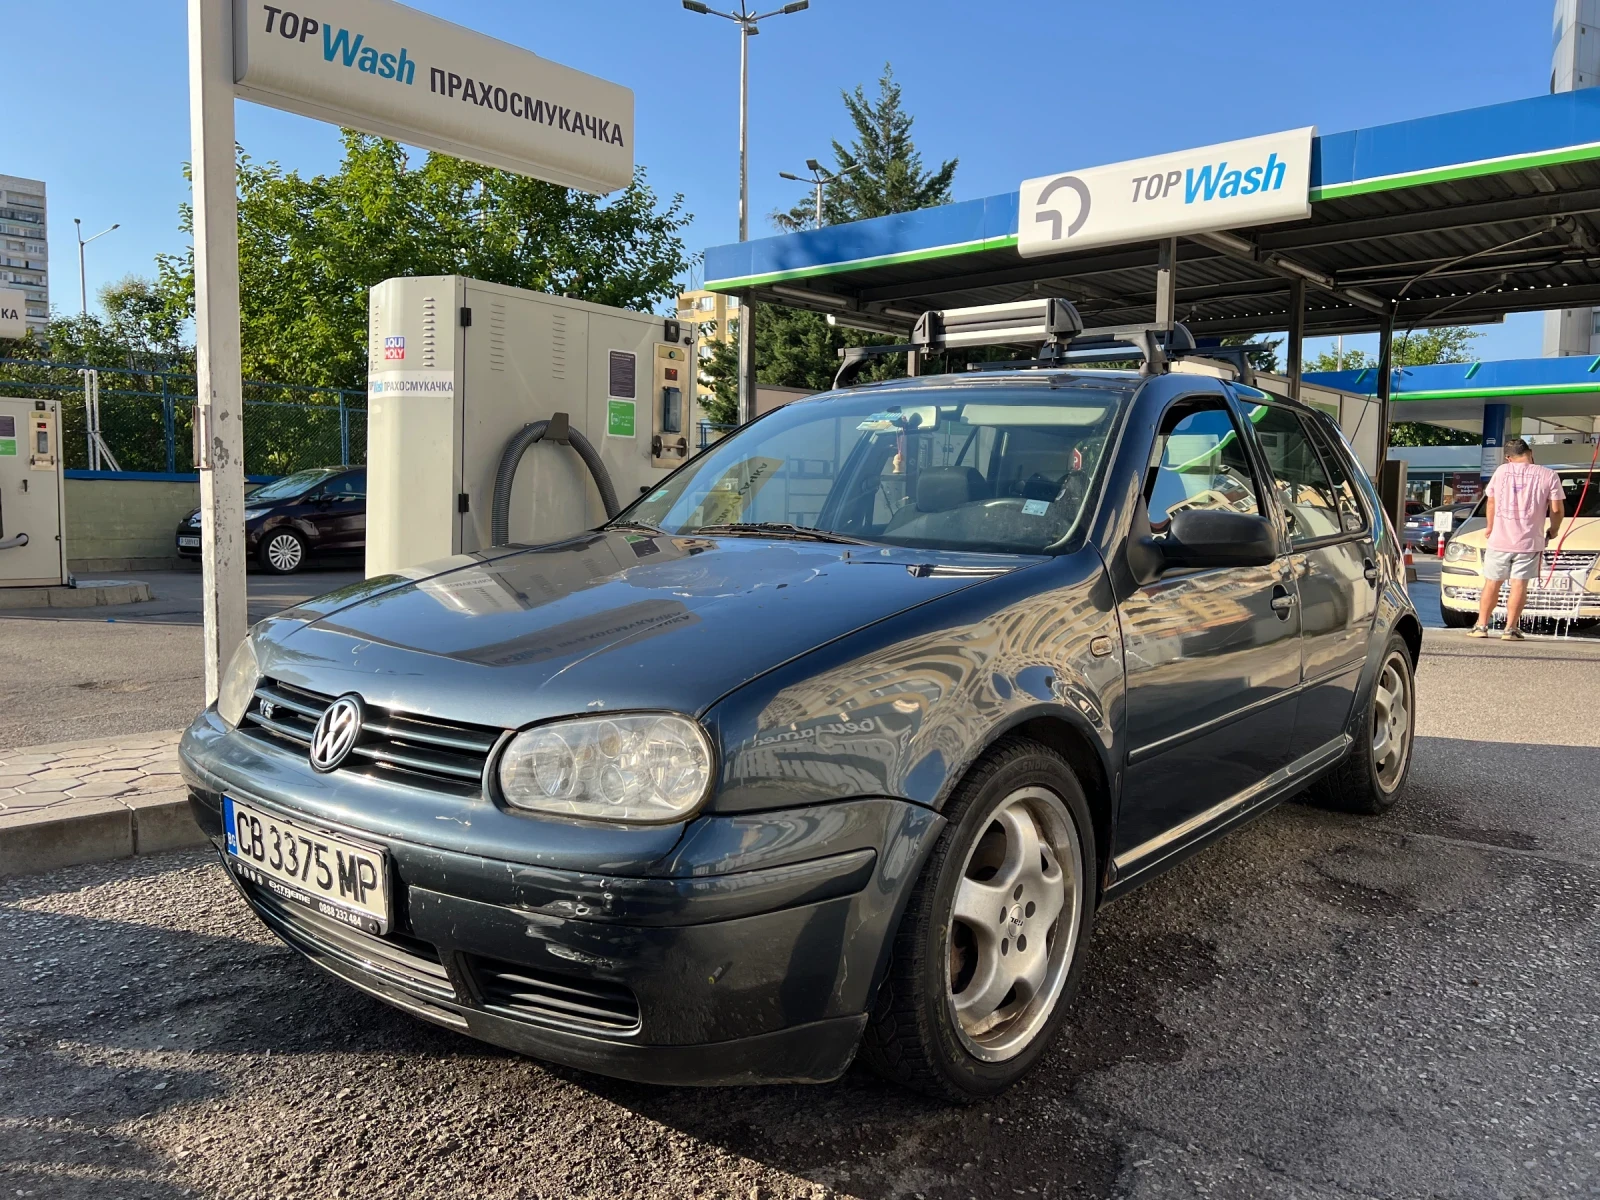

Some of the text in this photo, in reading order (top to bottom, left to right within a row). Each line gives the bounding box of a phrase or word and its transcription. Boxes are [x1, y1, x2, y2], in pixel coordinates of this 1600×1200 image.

[263, 5, 416, 85] TOP Wash
[429, 66, 624, 148] ПРАХОСМУКАЧКА
[1131, 152, 1287, 204] TOP Wash
[384, 380, 454, 392] ПРАХОСМУКАЧКА
[227, 832, 237, 847] BG
[269, 825, 334, 890] 3375
[335, 908, 349, 923] 232
